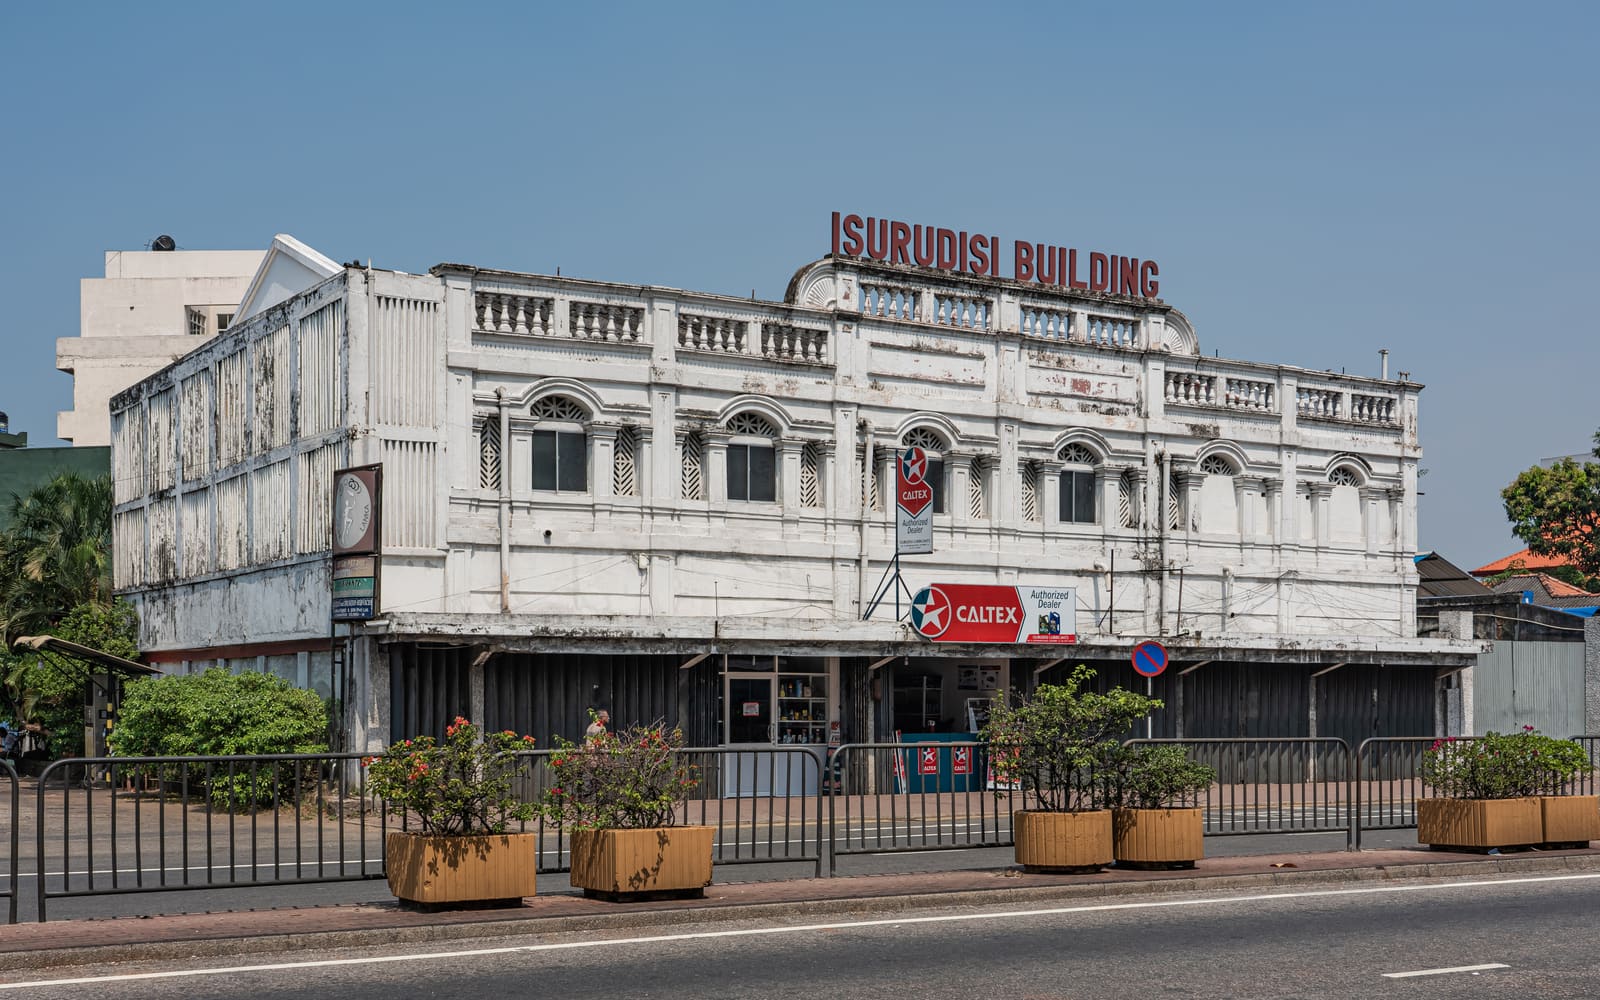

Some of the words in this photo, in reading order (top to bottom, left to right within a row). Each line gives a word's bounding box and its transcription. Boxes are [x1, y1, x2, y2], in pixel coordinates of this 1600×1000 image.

[832, 211, 1000, 277] ISURUDISI
[1014, 239, 1159, 298] BUILDING
[902, 489, 928, 501] CALTEX
[902, 518, 928, 526] Authorized
[907, 526, 923, 534] Dealer
[1030, 589, 1069, 600] Authorized
[1038, 600, 1062, 609] Dealer
[956, 605, 1018, 624] CALTEX
